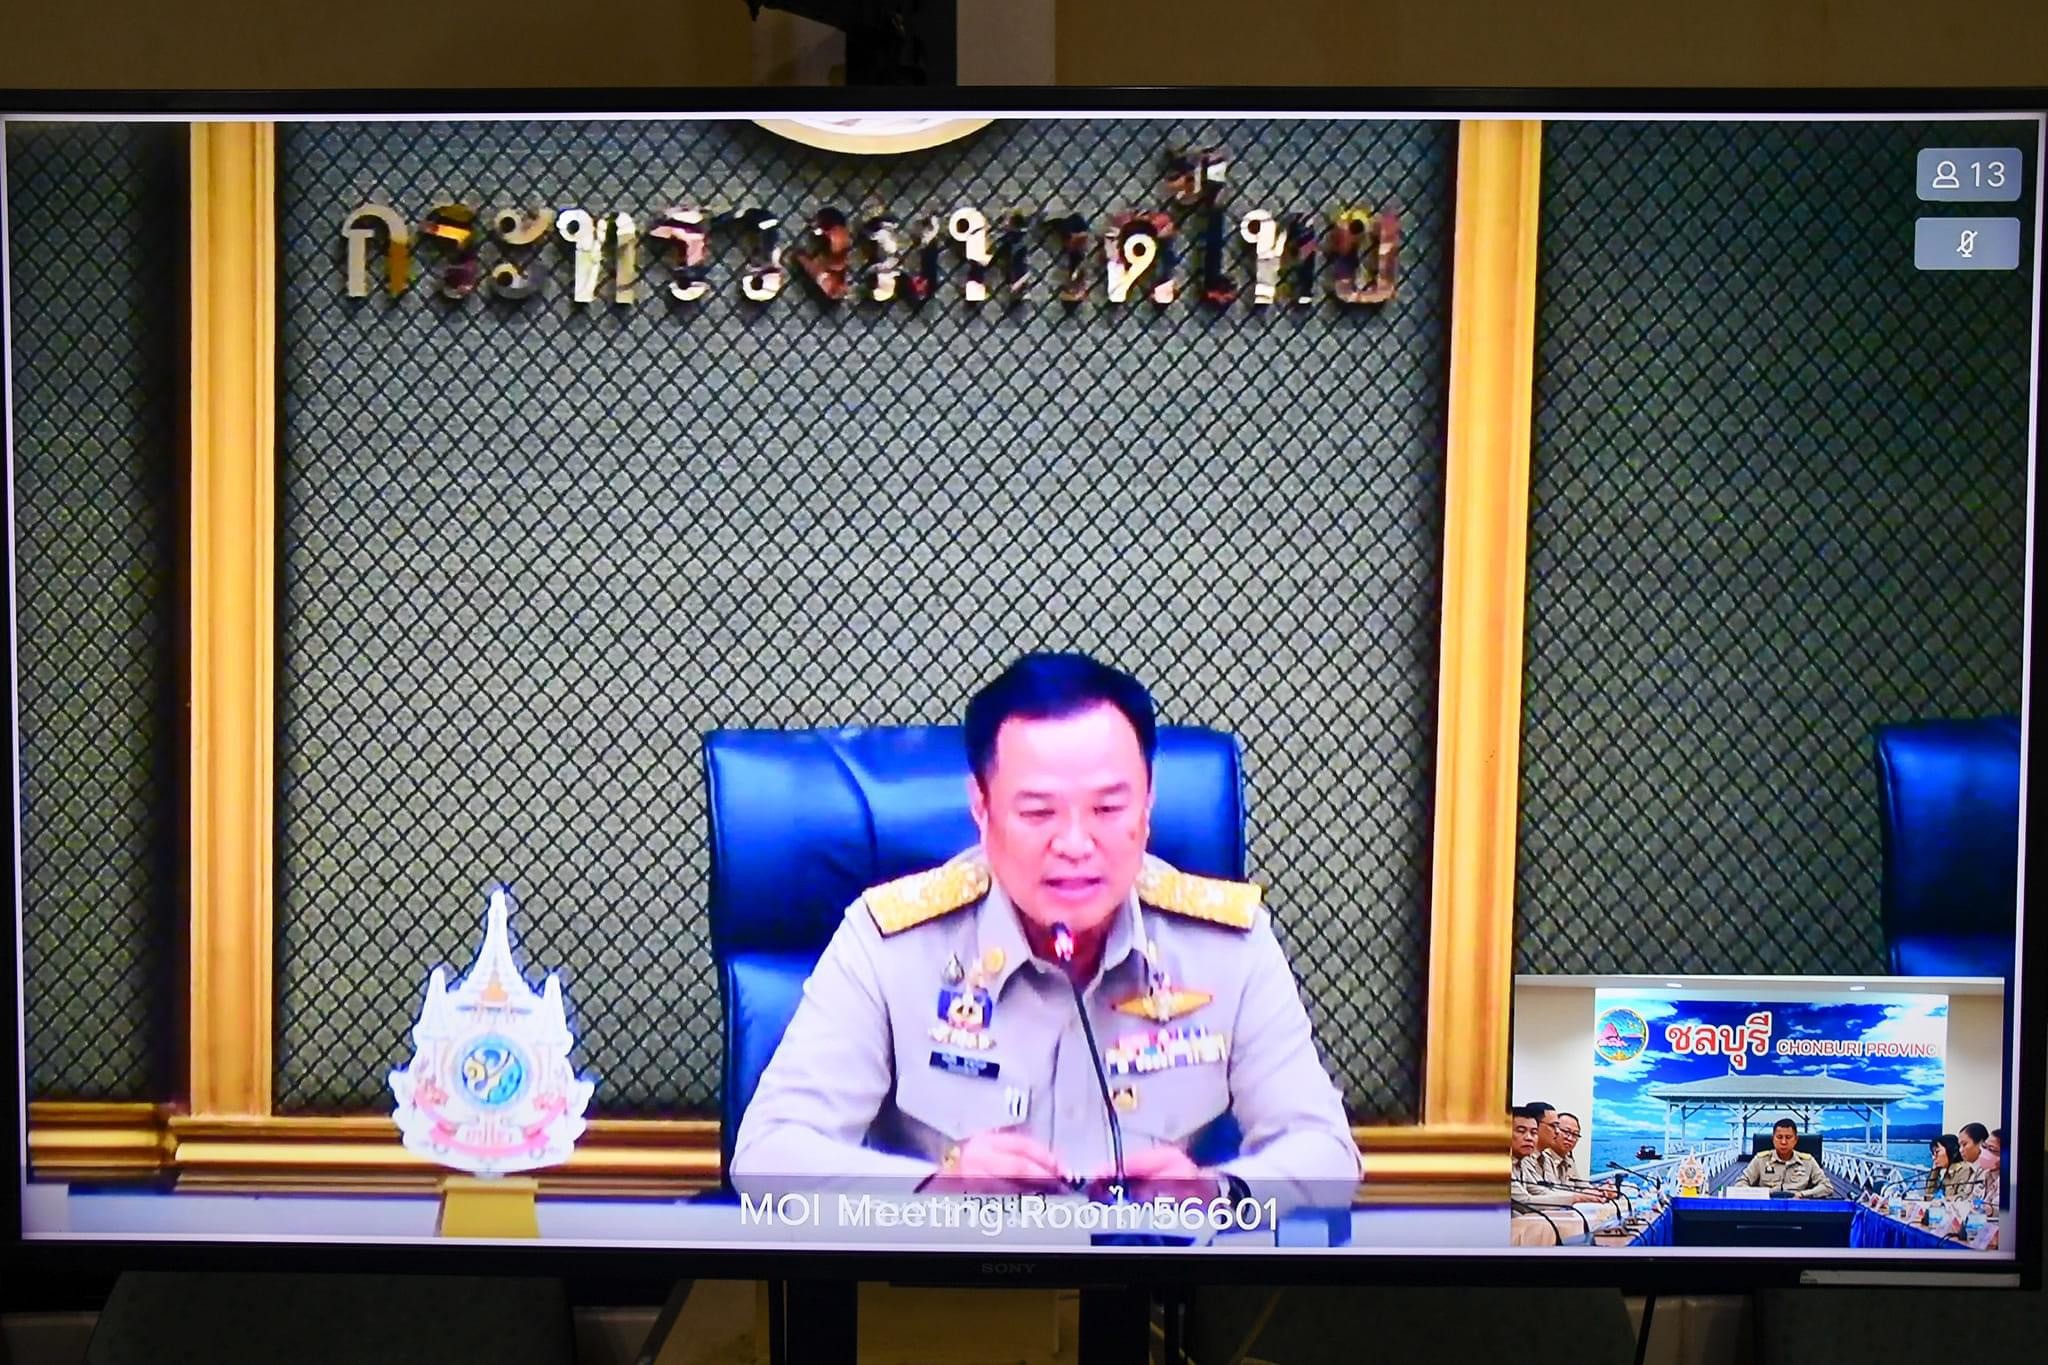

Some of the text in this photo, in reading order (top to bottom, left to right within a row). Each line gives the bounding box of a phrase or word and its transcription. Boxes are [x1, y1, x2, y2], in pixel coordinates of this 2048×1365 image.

[1971, 161, 2005, 187] 13
[342, 147, 1400, 306] กระทรวงมหาดไทย
[1667, 1012, 1771, 1068] ชลบุรี
[1777, 1040, 1862, 1056] CHONBURI
[740, 1192, 820, 1226] MOI
[838, 1193, 1004, 1237] Meeting
[1021, 1196, 1138, 1229] Room
[1153, 1196, 1279, 1231] 56601
[981, 1263, 1036, 1274] SONY
